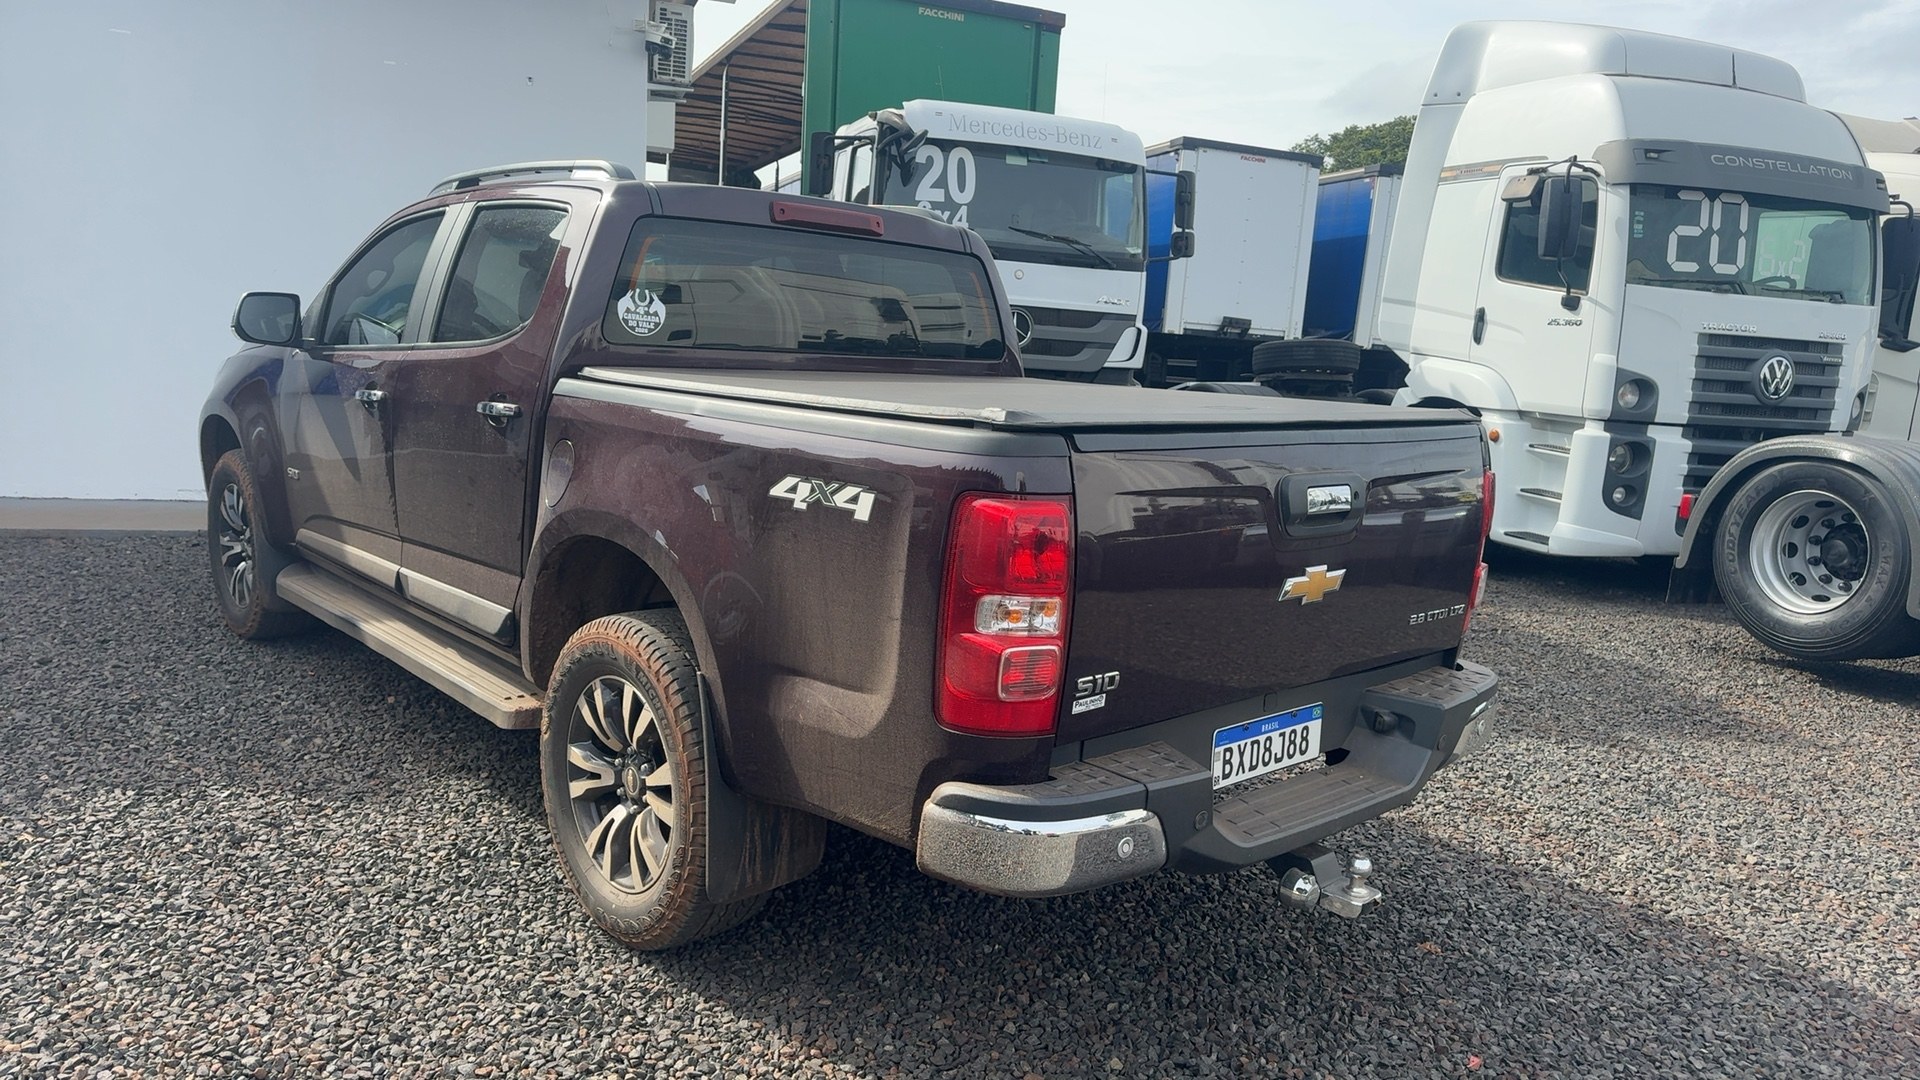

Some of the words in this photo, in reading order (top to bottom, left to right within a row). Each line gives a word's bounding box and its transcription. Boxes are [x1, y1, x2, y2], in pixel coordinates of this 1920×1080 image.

[918, 6, 965, 22] FACCHINI
[949, 113, 1103, 149] Mercedes-Benz
[1240, 154, 1266, 164] FACCHINI
[915, 144, 976, 204] 20
[1711, 154, 1853, 181] CONSTELLATION
[917, 201, 969, 229] x4
[1667, 190, 1749, 275] 20
[624, 313, 659, 323] CAVALGADA
[638, 321, 655, 329] VALE
[1701, 321, 1757, 333] TRACTOR
[1450, 604, 1466, 616] LTZ
[1075, 671, 1120, 698] S10
[1261, 721, 1279, 733] BRASIL
[1221, 725, 1310, 781] BXD8J88
[1213, 775, 1221, 787] BR
